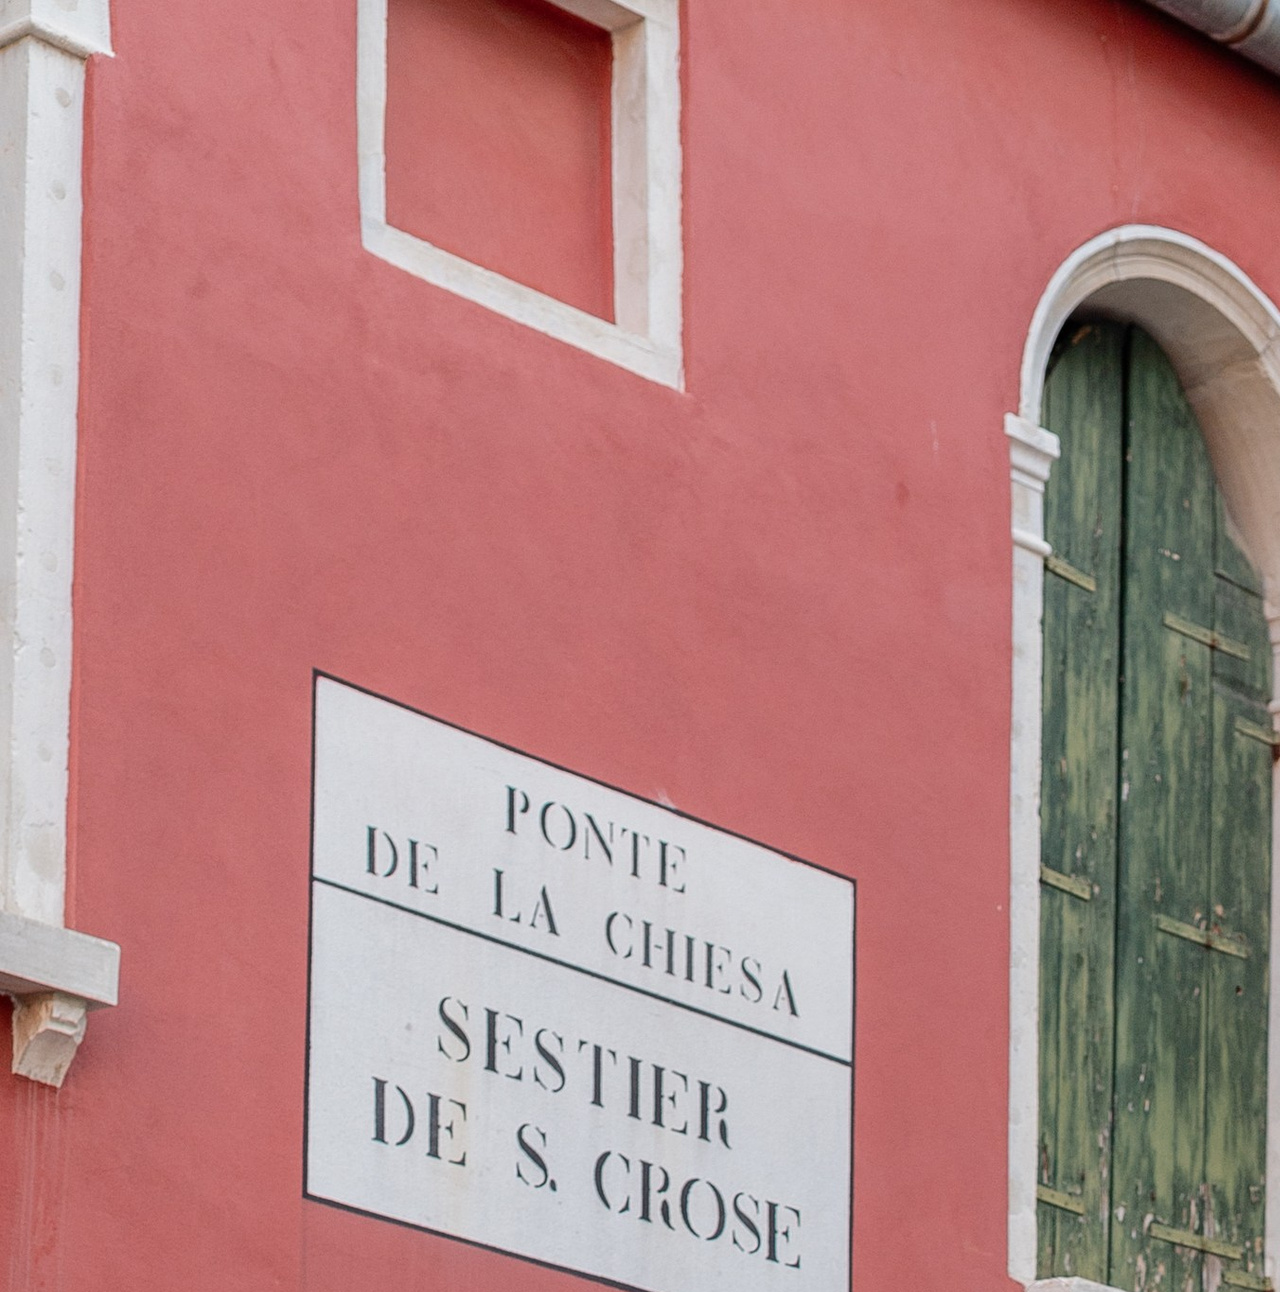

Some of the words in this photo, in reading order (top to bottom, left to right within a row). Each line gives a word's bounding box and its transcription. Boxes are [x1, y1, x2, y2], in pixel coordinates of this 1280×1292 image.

[364, 824, 440, 896] DE
[491, 867, 561, 938] LA
[604, 910, 800, 1019] CHIESA
[504, 784, 687, 895] PONTE
[436, 996, 732, 1150] SESTIER
[370, 1075, 468, 1168] DE
[515, 1122, 559, 1193] S.
[592, 1149, 802, 1270] CROSE
